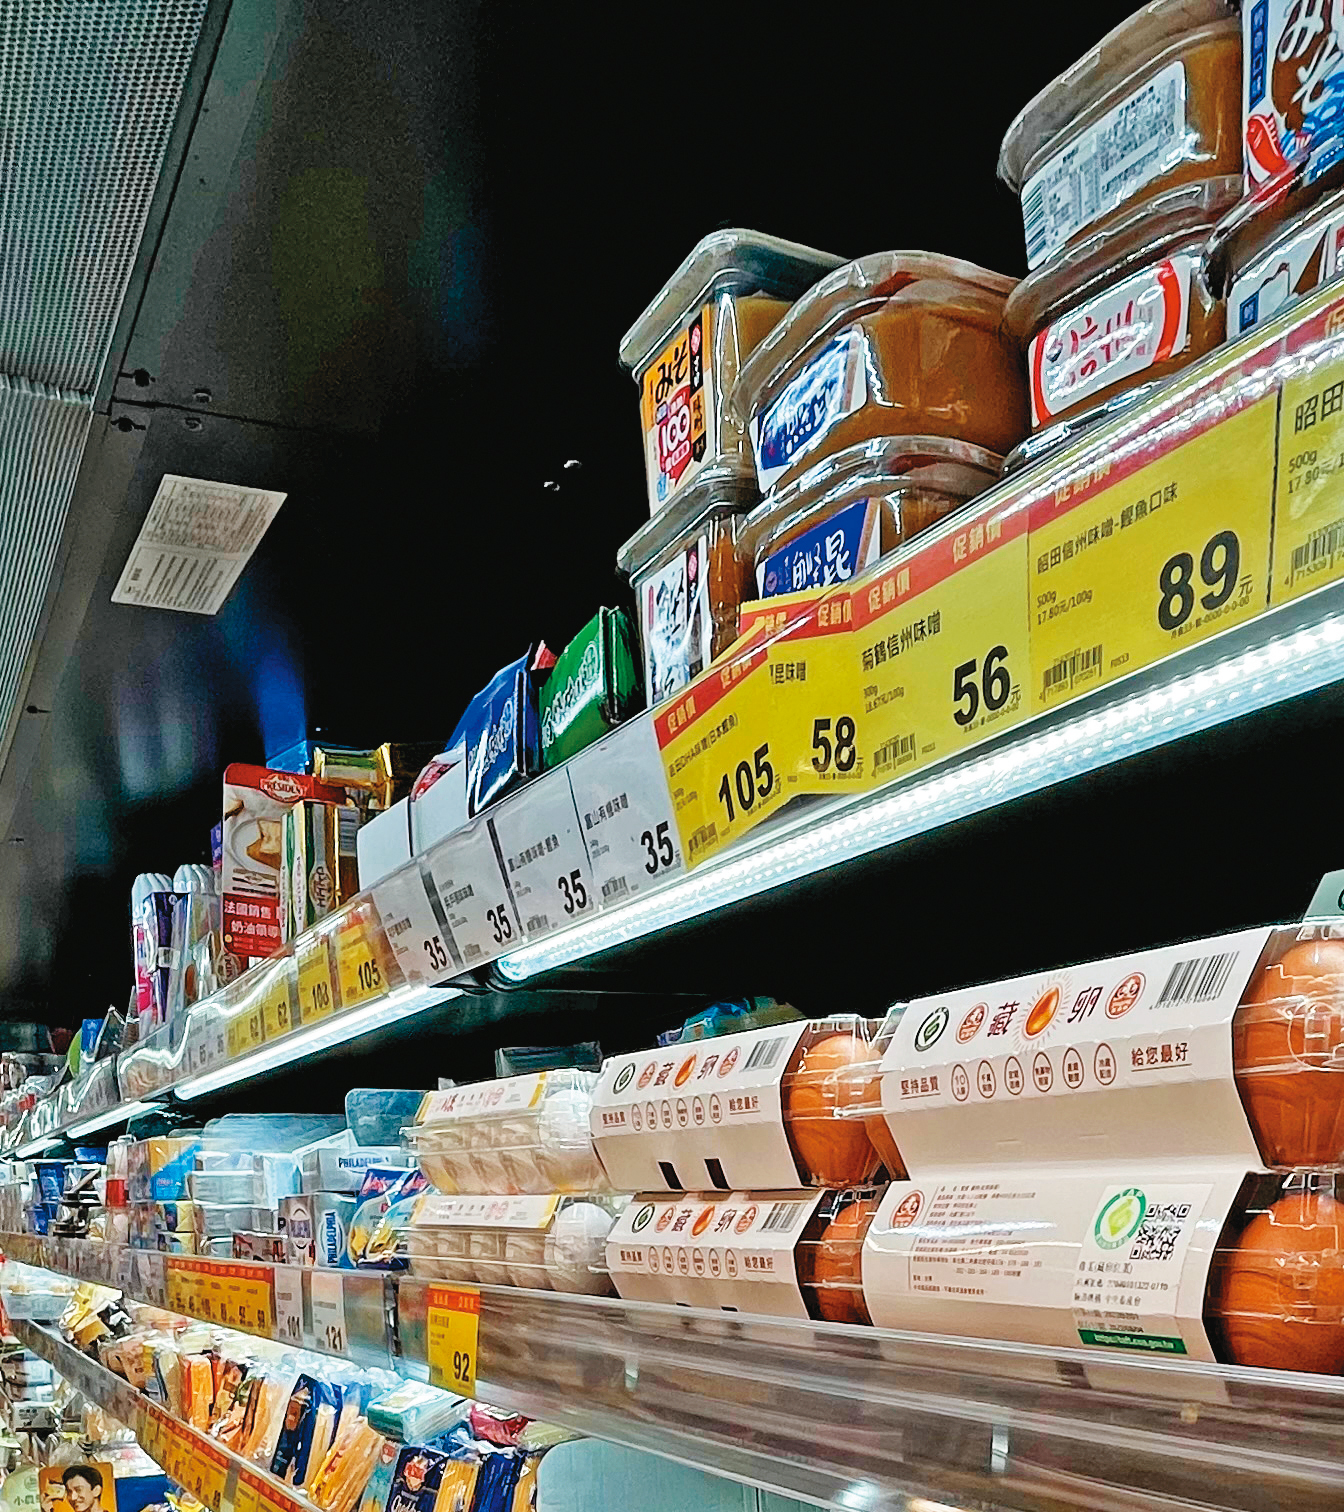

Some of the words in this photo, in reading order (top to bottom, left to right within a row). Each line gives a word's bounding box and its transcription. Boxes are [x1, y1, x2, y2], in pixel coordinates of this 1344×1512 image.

[952, 519, 1003, 564] 促銷價
[867, 567, 911, 614] 促銷價
[1157, 530, 1240, 631] 89
[953, 645, 1011, 726] 56
[666, 695, 697, 734] 促銷價
[811, 716, 857, 773] 58
[718, 742, 775, 821] 105
[640, 821, 675, 876] 35
[558, 869, 588, 915] 35
[486, 904, 512, 943] 35
[423, 935, 447, 972] 35
[987, 1001, 1019, 1038] 藏
[1067, 984, 1103, 1024] 卵
[900, 1072, 942, 1097] 堅持品質
[1130, 1041, 1190, 1069] 給您最好
[452, 1350, 471, 1383] 92
